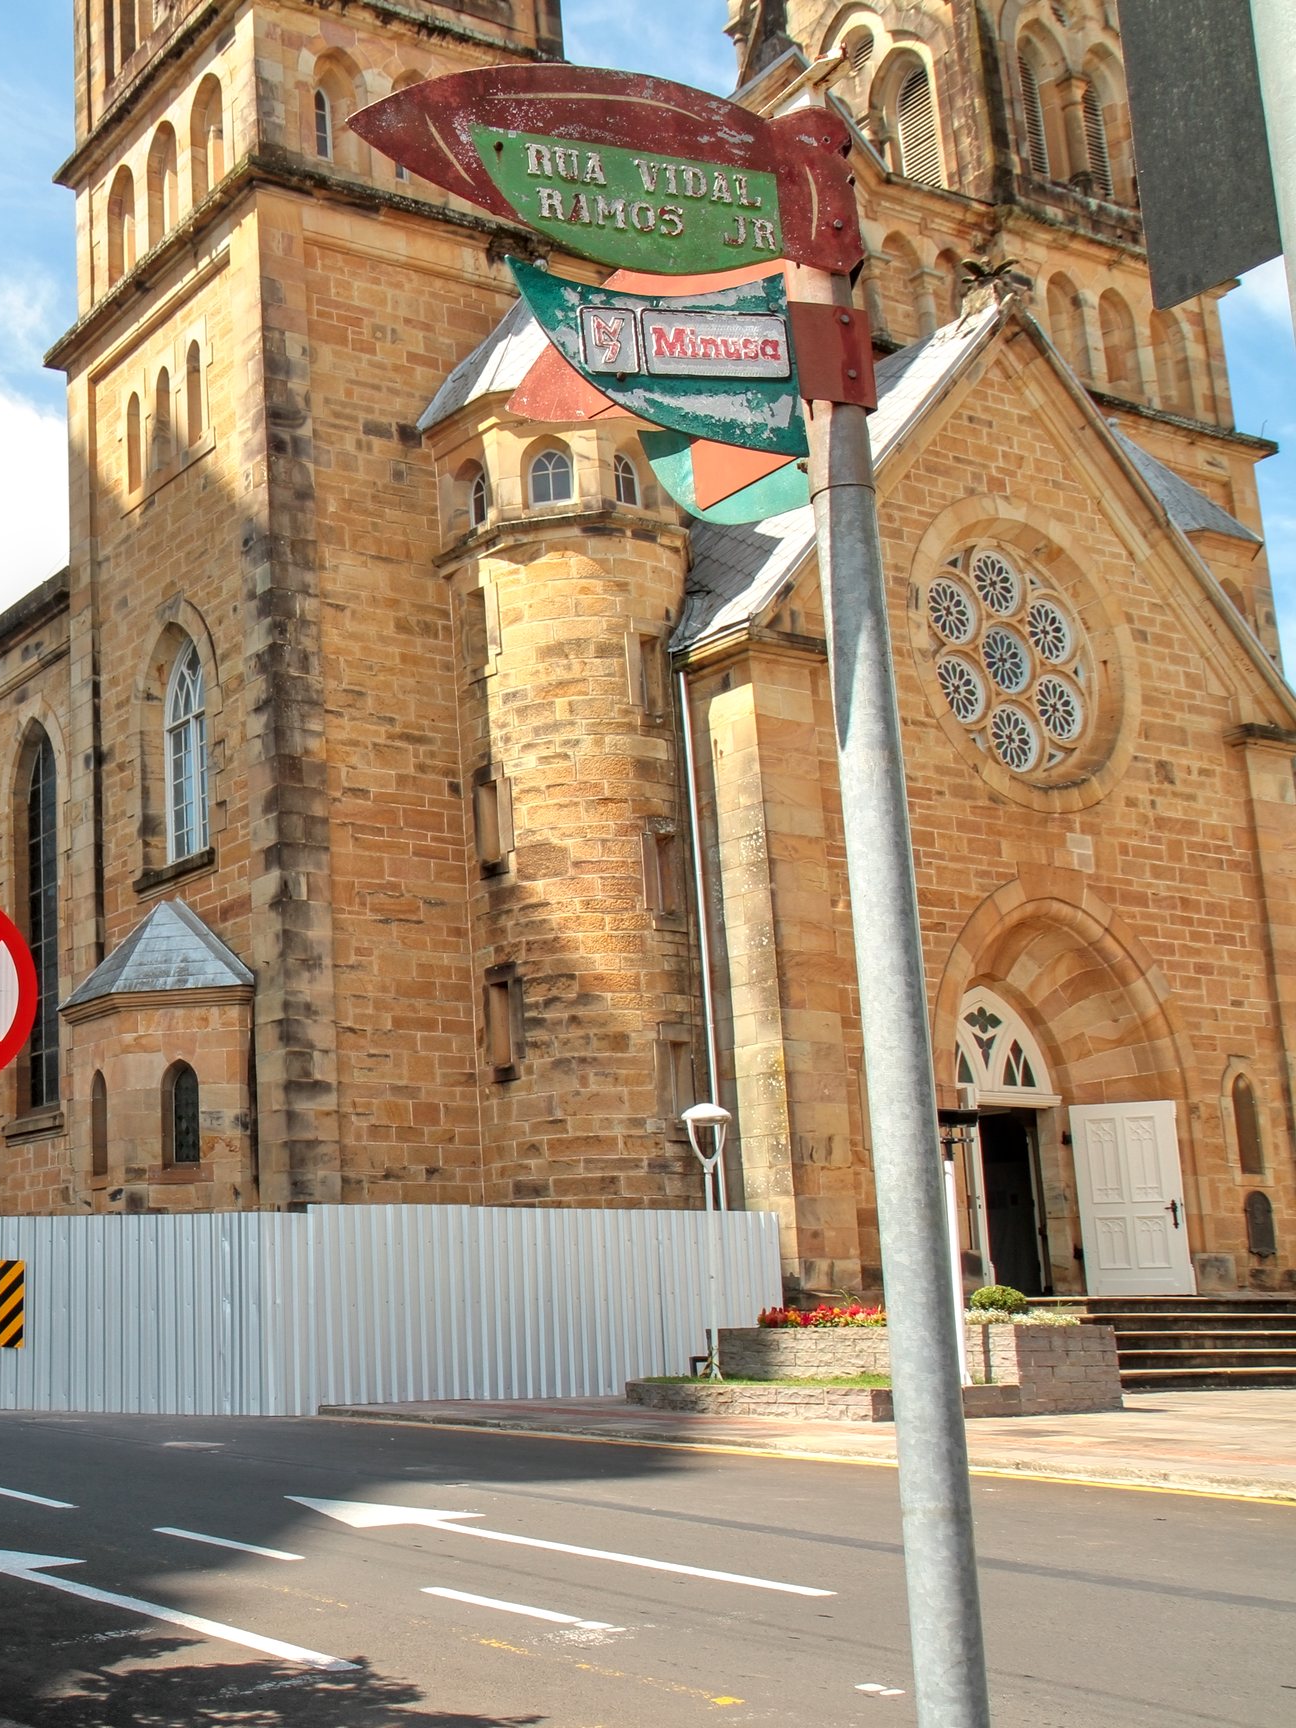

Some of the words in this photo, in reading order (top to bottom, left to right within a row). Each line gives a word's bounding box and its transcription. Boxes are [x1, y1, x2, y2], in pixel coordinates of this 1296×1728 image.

[524, 142, 607, 186] RUA
[633, 158, 762, 208] VIDAL
[535, 186, 685, 237] RAMOS
[723, 215, 777, 251] JR
[650, 324, 782, 361] Minusa
